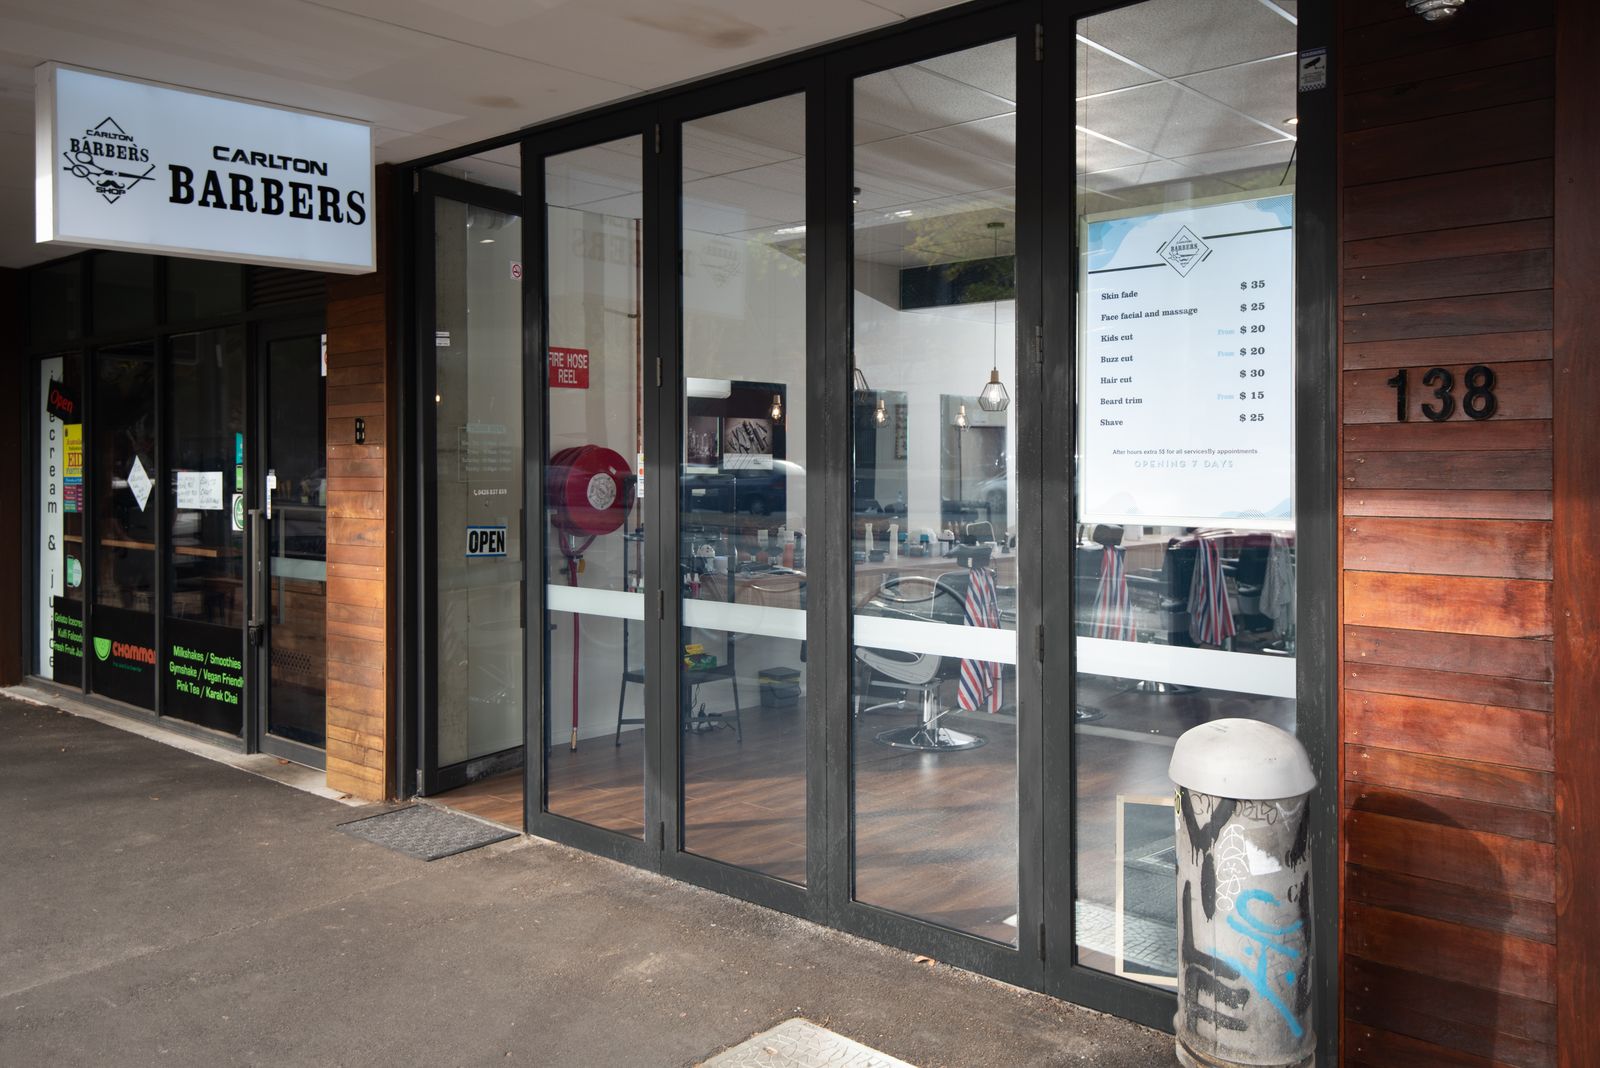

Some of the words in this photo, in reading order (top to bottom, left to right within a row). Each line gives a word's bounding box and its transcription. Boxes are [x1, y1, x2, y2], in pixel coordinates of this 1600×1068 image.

[86, 129, 134, 142] CARLTON
[70, 137, 150, 163] BARBERS
[213, 145, 328, 176] CARLTON
[96, 186, 127, 195] SHOP
[168, 164, 366, 225] BARBERS
[1240, 281, 1247, 290] $
[1251, 280, 1266, 289] 35
[1101, 292, 1119, 301] Skin
[1121, 290, 1138, 299] fade
[1240, 303, 1247, 312] $
[1251, 302, 1266, 311] 25
[1101, 313, 1119, 322] Face
[1120, 311, 1143, 320] facial
[1145, 309, 1160, 318] and
[1162, 306, 1198, 317] massage
[1240, 325, 1247, 334] $
[1251, 324, 1266, 333] 20
[1101, 334, 1119, 343] Kids
[1120, 333, 1133, 341] cut
[1240, 347, 1247, 356] $
[1251, 347, 1266, 355] 20
[567, 352, 588, 369] HOSE
[558, 368, 578, 384] REEL
[1239, 369, 1247, 378] $
[1250, 368, 1265, 377] 30
[1119, 375, 1132, 384] cut
[1239, 391, 1247, 400] $
[1250, 391, 1265, 399] 15
[1387, 365, 1497, 422] 138
[50, 389, 74, 414] Open
[1100, 397, 1123, 405] Beard
[1125, 396, 1143, 405] trim
[1100, 418, 1123, 426] Shave
[1239, 413, 1247, 422] $
[1250, 413, 1265, 422] 25
[1134, 460, 1186, 468] OPENING
[1191, 459, 1198, 468] 7
[1203, 459, 1233, 468] DAYS
[48, 534, 57, 551] &
[468, 530, 505, 553] OPEN
[173, 645, 204, 662] Milkshakes
[210, 652, 241, 670] Smoothies
[169, 661, 198, 678] Gymshake
[203, 668, 221, 684] Vegan
[176, 679, 189, 692] Pink
[189, 682, 200, 696] Tea
[205, 686, 224, 701] Karak
[224, 690, 238, 704] Chai
